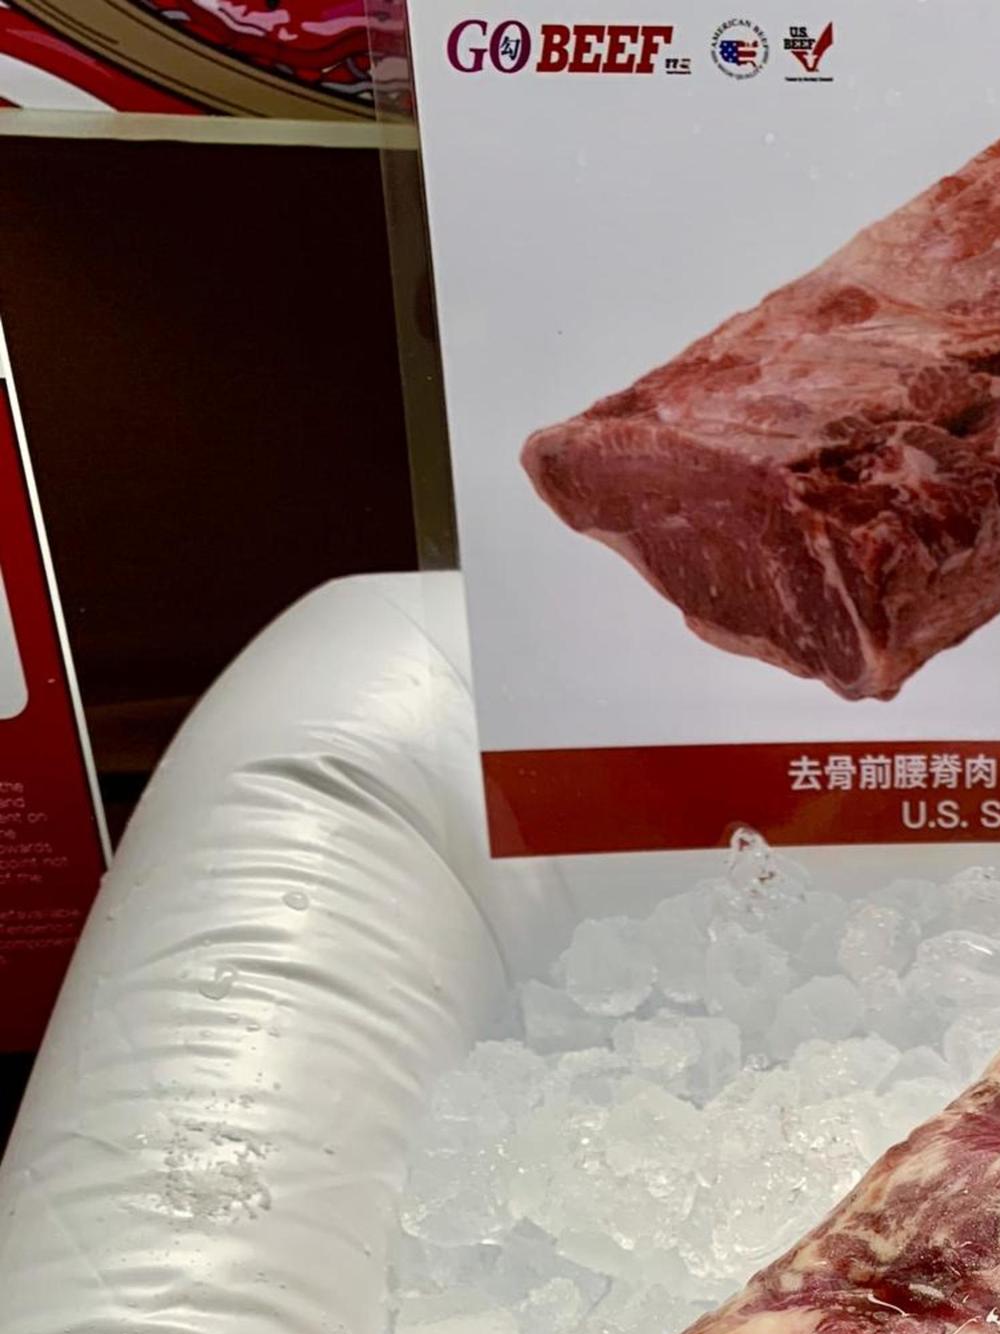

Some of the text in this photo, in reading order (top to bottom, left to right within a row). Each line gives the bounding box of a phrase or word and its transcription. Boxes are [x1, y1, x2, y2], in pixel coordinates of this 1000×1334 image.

[447, 18, 532, 74] GO
[536, 24, 673, 74] BEEF
[711, 18, 751, 48] AMERICAN
[784, 38, 815, 50] BEEF
[902, 801, 967, 828] U.S.
